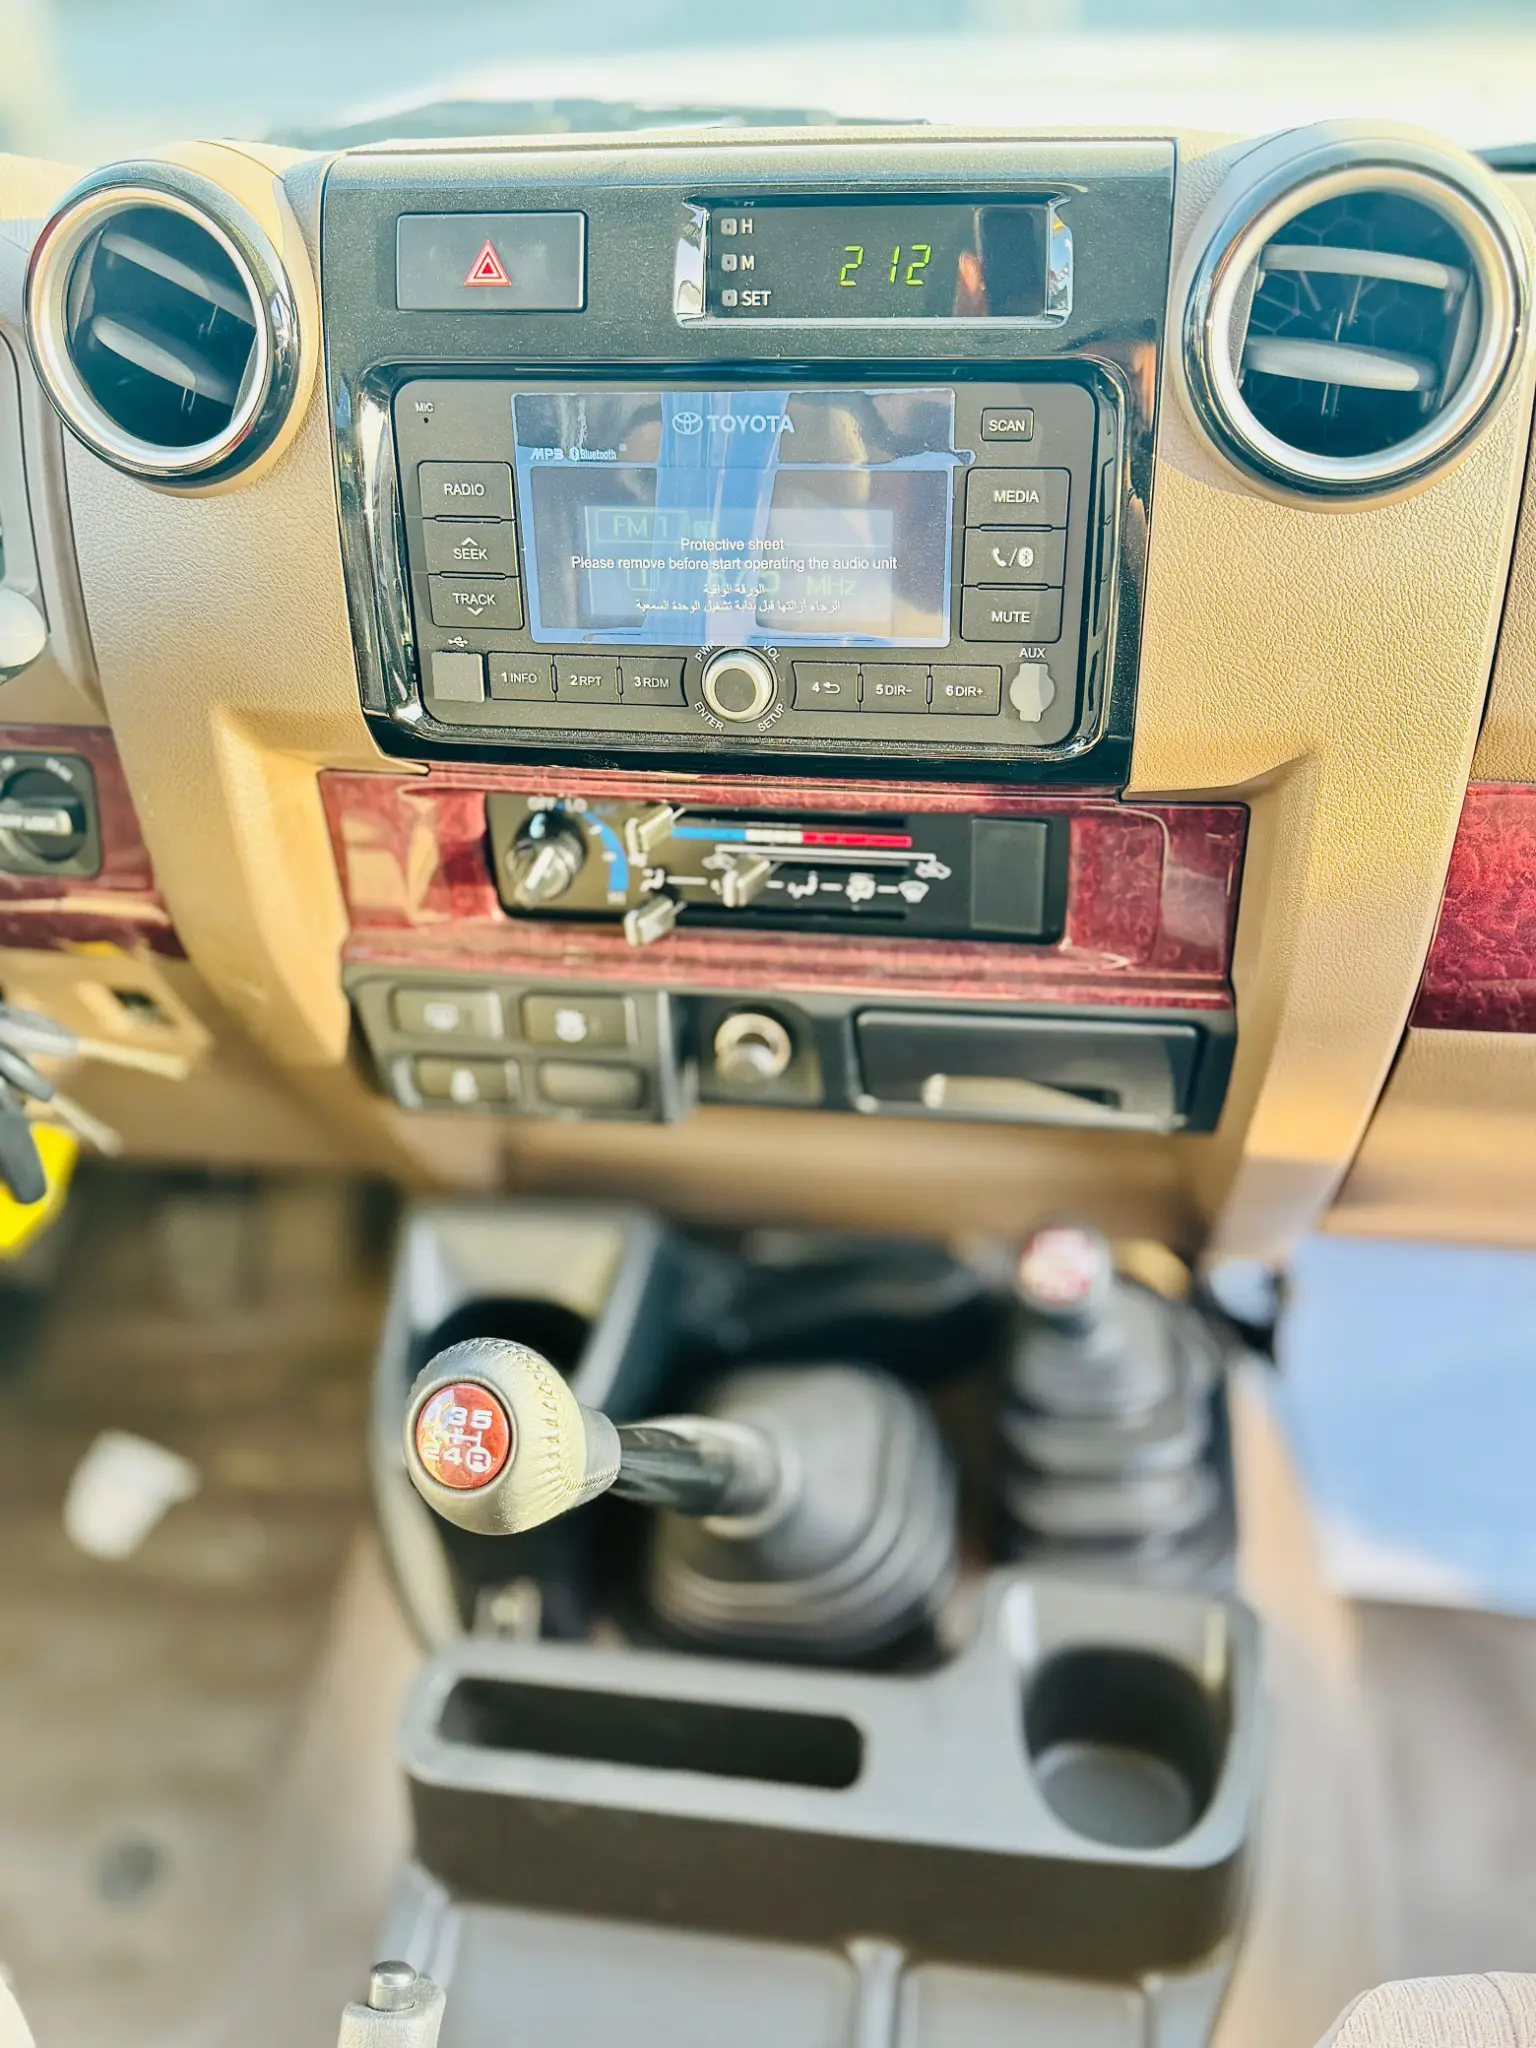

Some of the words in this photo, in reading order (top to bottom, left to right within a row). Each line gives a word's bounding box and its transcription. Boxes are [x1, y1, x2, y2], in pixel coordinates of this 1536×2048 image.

[741, 218, 753, 234] H
[740, 255, 755, 271] M
[741, 290, 771, 306] SET
[415, 402, 434, 413] MIC
[706, 414, 796, 434] TOYOTA
[988, 419, 1026, 433] SCAN
[580, 449, 617, 461] Bluetooth
[443, 482, 485, 497] RADIO
[993, 489, 1040, 504] MEDIA
[613, 515, 647, 538] FM
[680, 537, 745, 551] Protective
[748, 537, 785, 551] sheet
[453, 547, 488, 561] SEEK
[571, 555, 615, 569] Please
[618, 557, 665, 569] remove
[668, 556, 709, 570] before
[712, 557, 741, 570] start
[744, 557, 805, 573] operating
[808, 556, 829, 570] the
[833, 556, 869, 570] audio
[872, 556, 898, 570] unit
[452, 592, 496, 606] TRACK
[990, 610, 1031, 624] MUTE
[695, 640, 715, 662] PWR
[763, 641, 781, 664] VOL
[1018, 647, 1046, 660] AUX
[811, 682, 820, 693] 4
[694, 701, 724, 732] ENTER
[757, 703, 785, 732] SETUP
